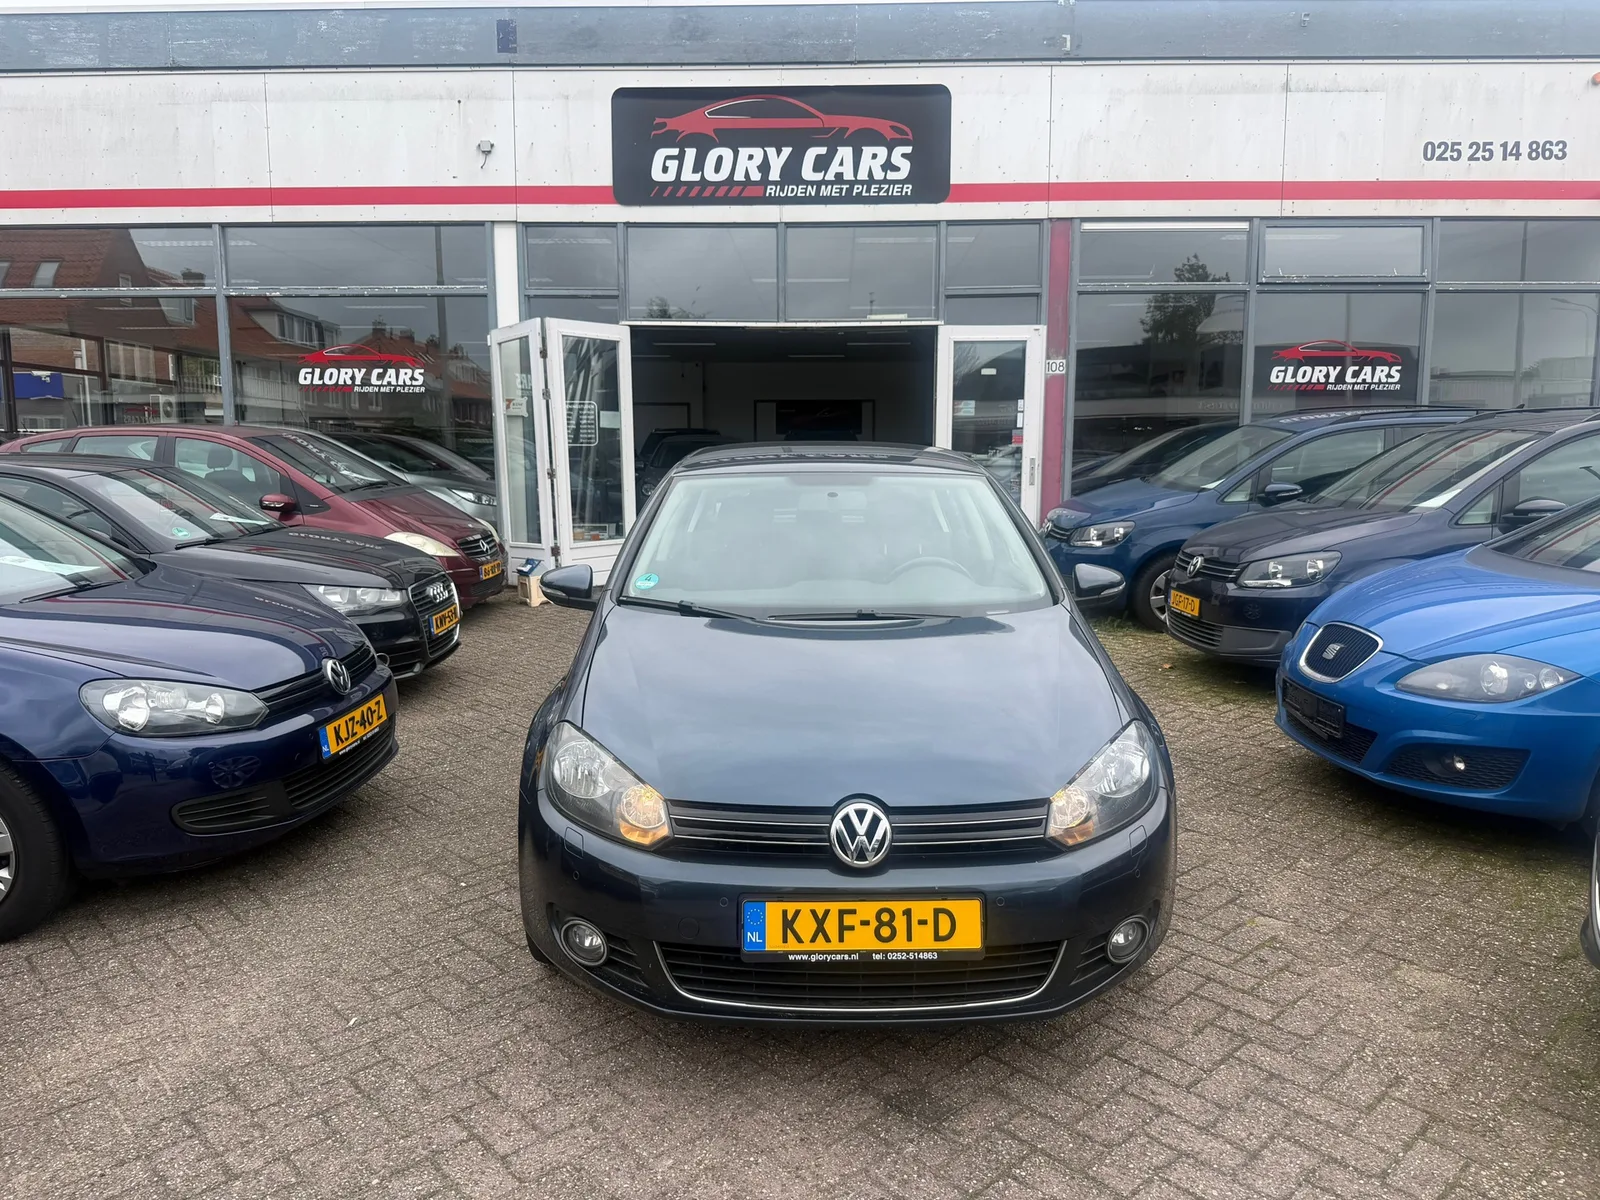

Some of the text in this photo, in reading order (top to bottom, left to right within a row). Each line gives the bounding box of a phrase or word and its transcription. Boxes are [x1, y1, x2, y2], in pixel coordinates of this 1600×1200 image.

[1422, 140, 1568, 162] 025 25 14 863
[650, 145, 913, 182] GLORY CARS
[765, 183, 913, 197] RIJDEN MET PLEZIER
[298, 367, 425, 386] GLORY CARS
[1046, 361, 1065, 373] 108
[1269, 365, 1402, 384] GLORY CARS
[1326, 383, 1401, 391] RIJDEN MET PLEZIER
[333, 700, 383, 746] KJZ-40-Z
[781, 907, 957, 944] KXF-81-D
[747, 931, 763, 943] NL
[788, 951, 938, 962] www.glorycars.nl tel: 0252-514863
